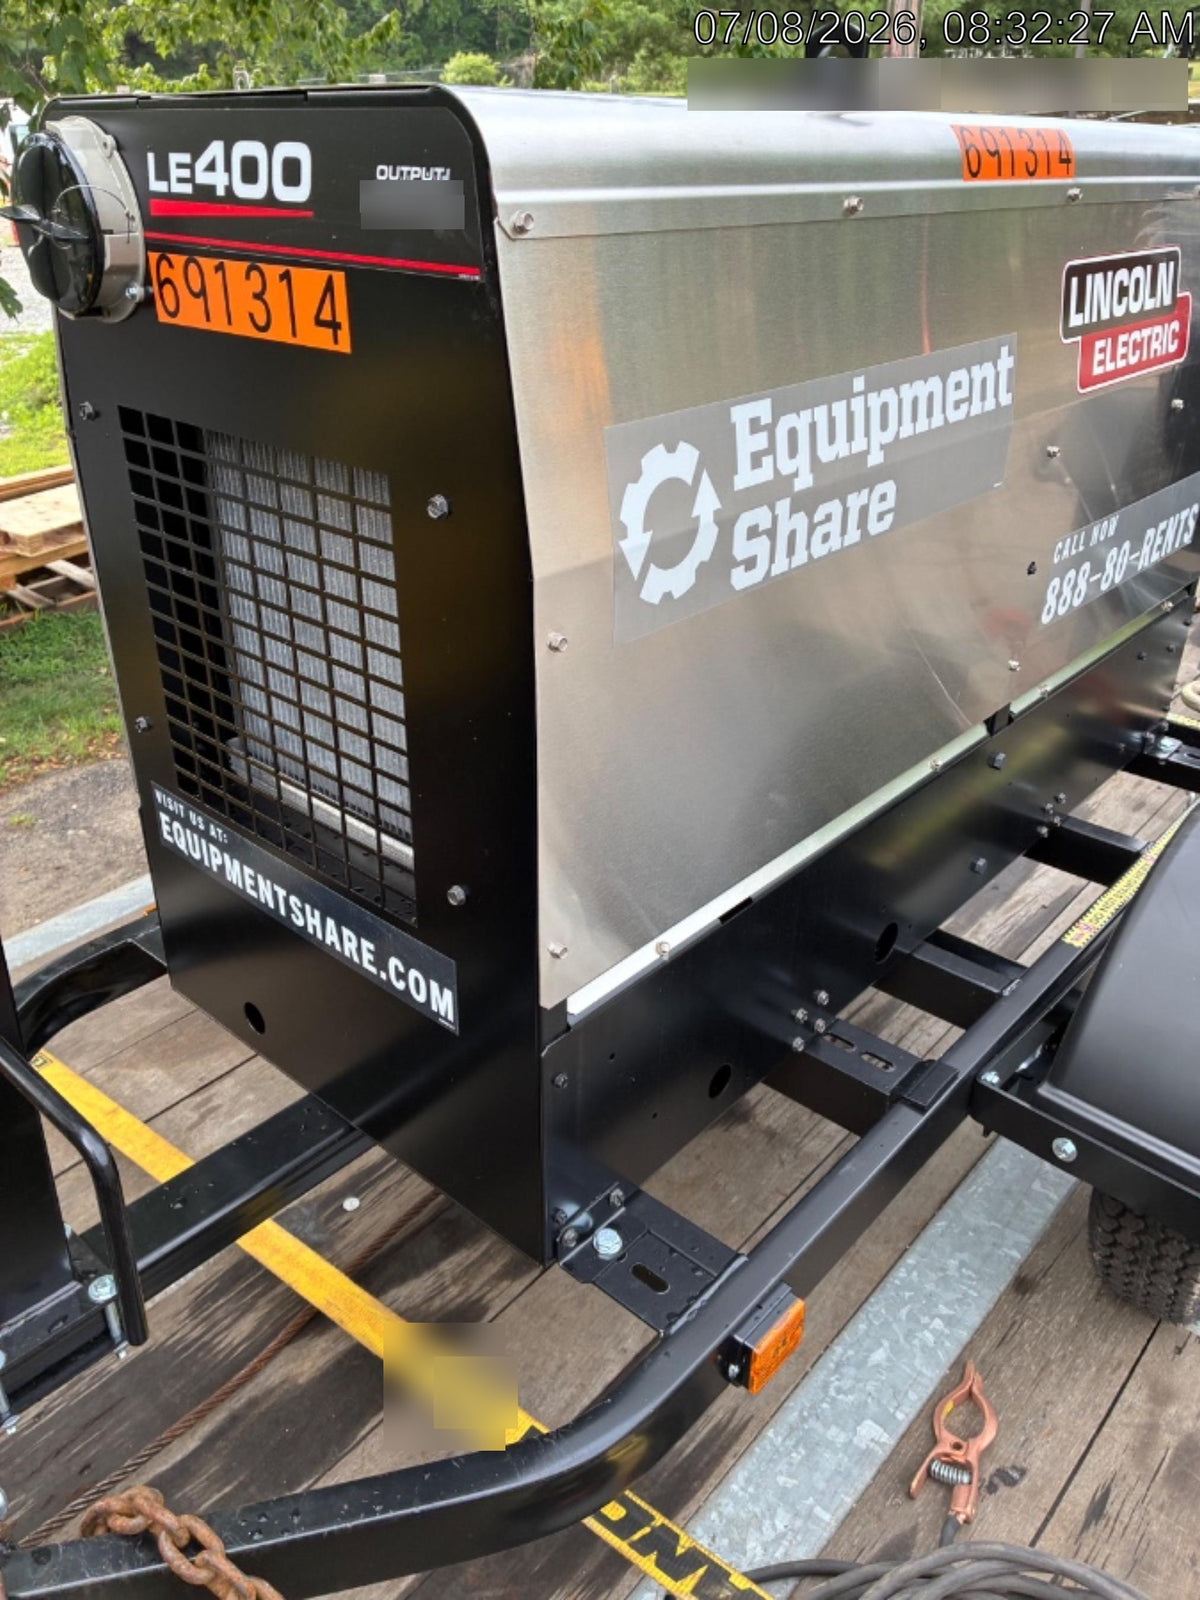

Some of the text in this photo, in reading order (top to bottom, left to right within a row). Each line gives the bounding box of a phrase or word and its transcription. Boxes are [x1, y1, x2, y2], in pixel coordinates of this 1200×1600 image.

[147, 140, 312, 202] LE400
[961, 126, 1072, 178] 691314
[155, 253, 343, 345] 691314
[1069, 261, 1175, 327] LINCOLN
[1093, 320, 1180, 376] ELECTRIC
[731, 344, 1016, 492] Equipment
[730, 478, 898, 592] Share
[1041, 502, 1200, 625] 888-80-RENTS
[1053, 514, 1120, 565] CALL NOW
[154, 788, 229, 844] VISIT US AT:
[159, 811, 455, 1024] EQUIPMENTSHARE.COM
